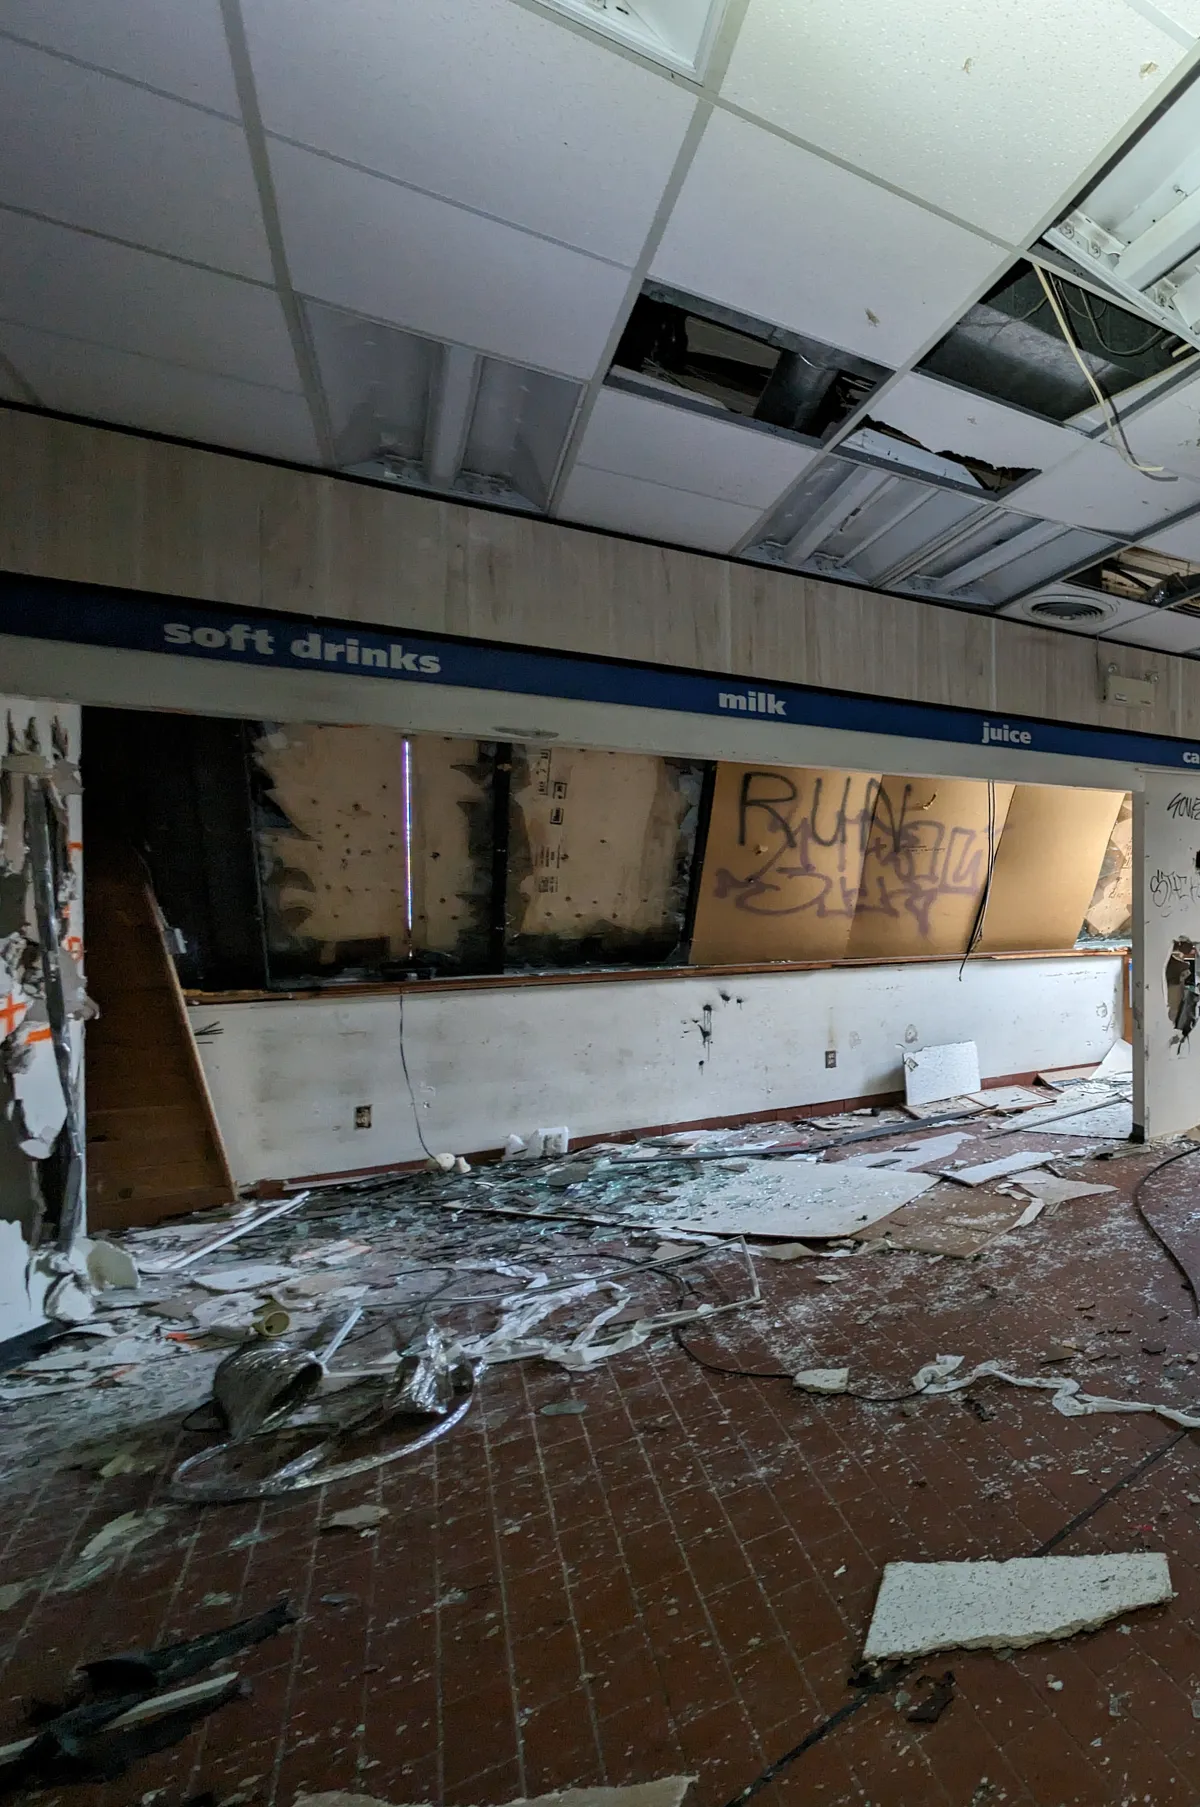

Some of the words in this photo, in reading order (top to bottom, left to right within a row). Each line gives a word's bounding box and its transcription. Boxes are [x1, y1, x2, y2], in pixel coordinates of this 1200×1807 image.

[163, 621, 275, 658] soft
[291, 635, 441, 675] drinks
[718, 691, 787, 716] milk
[981, 721, 1032, 745] juice
[737, 770, 912, 853] RUN
